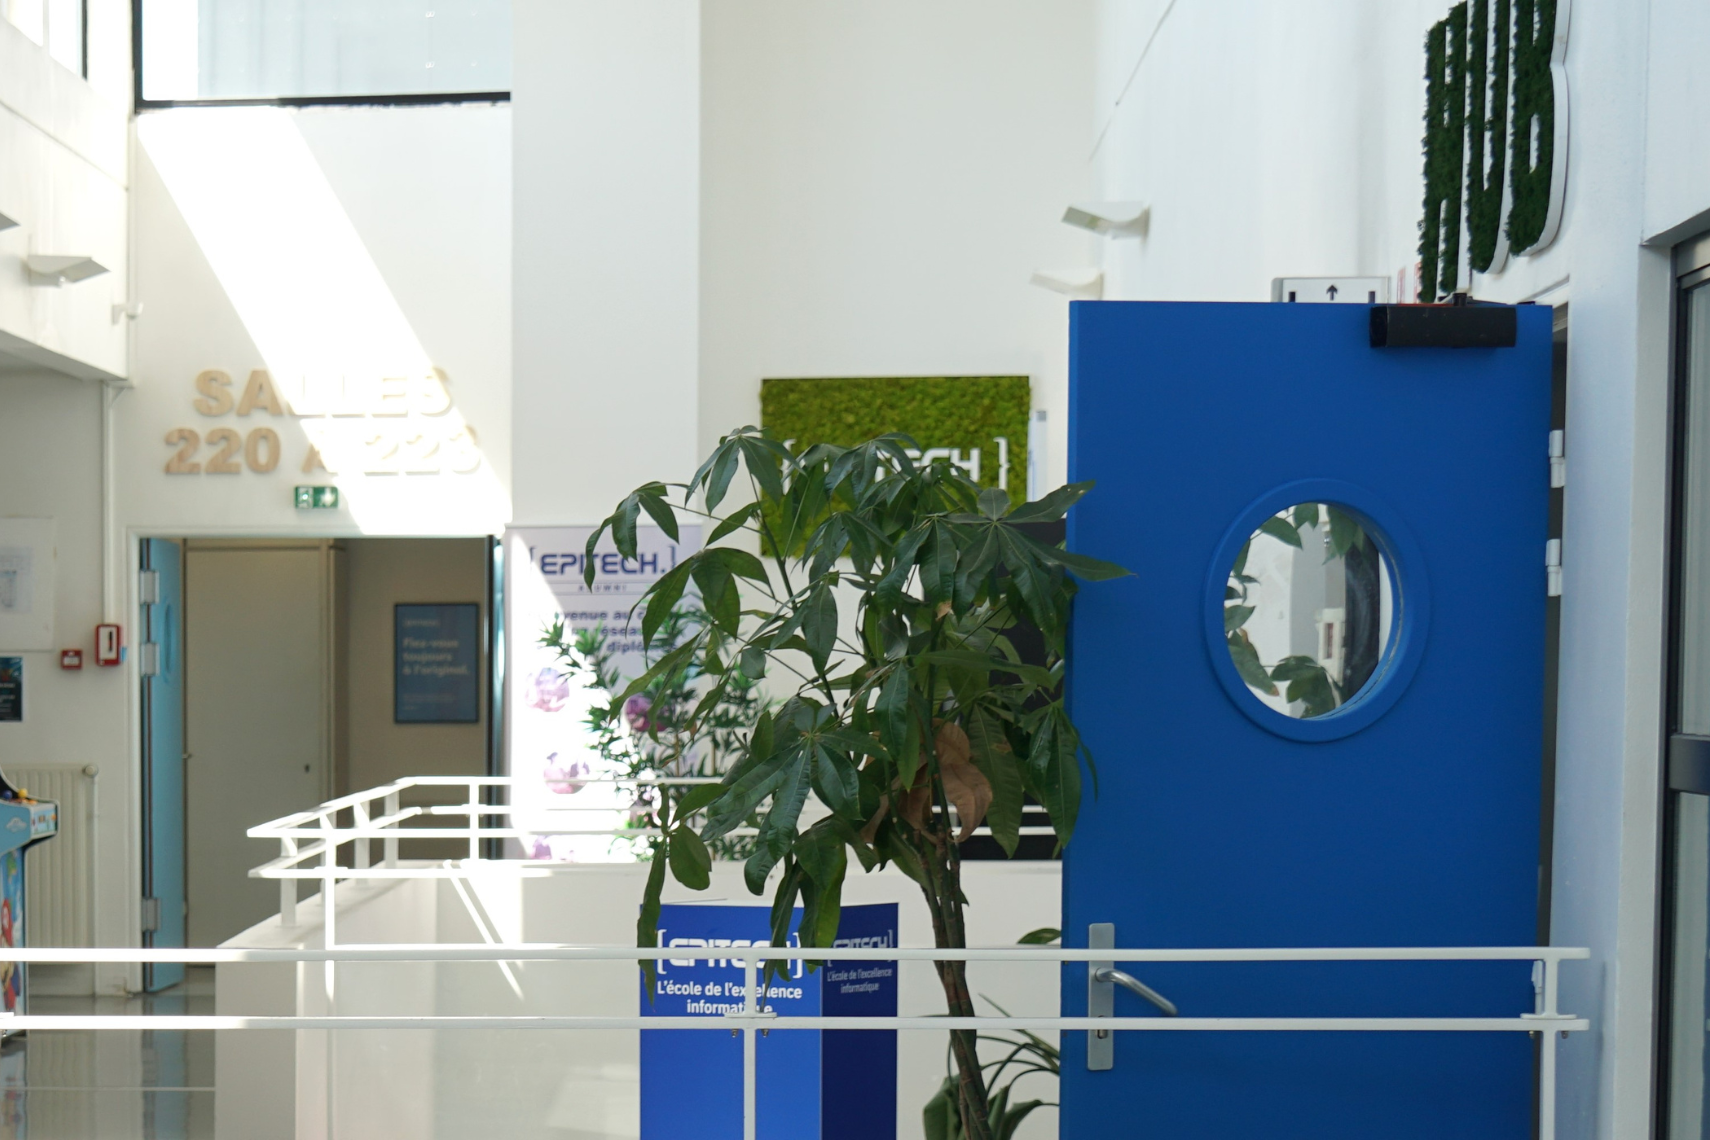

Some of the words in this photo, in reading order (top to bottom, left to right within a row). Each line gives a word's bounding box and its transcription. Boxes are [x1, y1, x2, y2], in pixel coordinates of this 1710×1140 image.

[163, 427, 281, 475] 220
[657, 980, 702, 996] L'école
[704, 982, 722, 996] de
